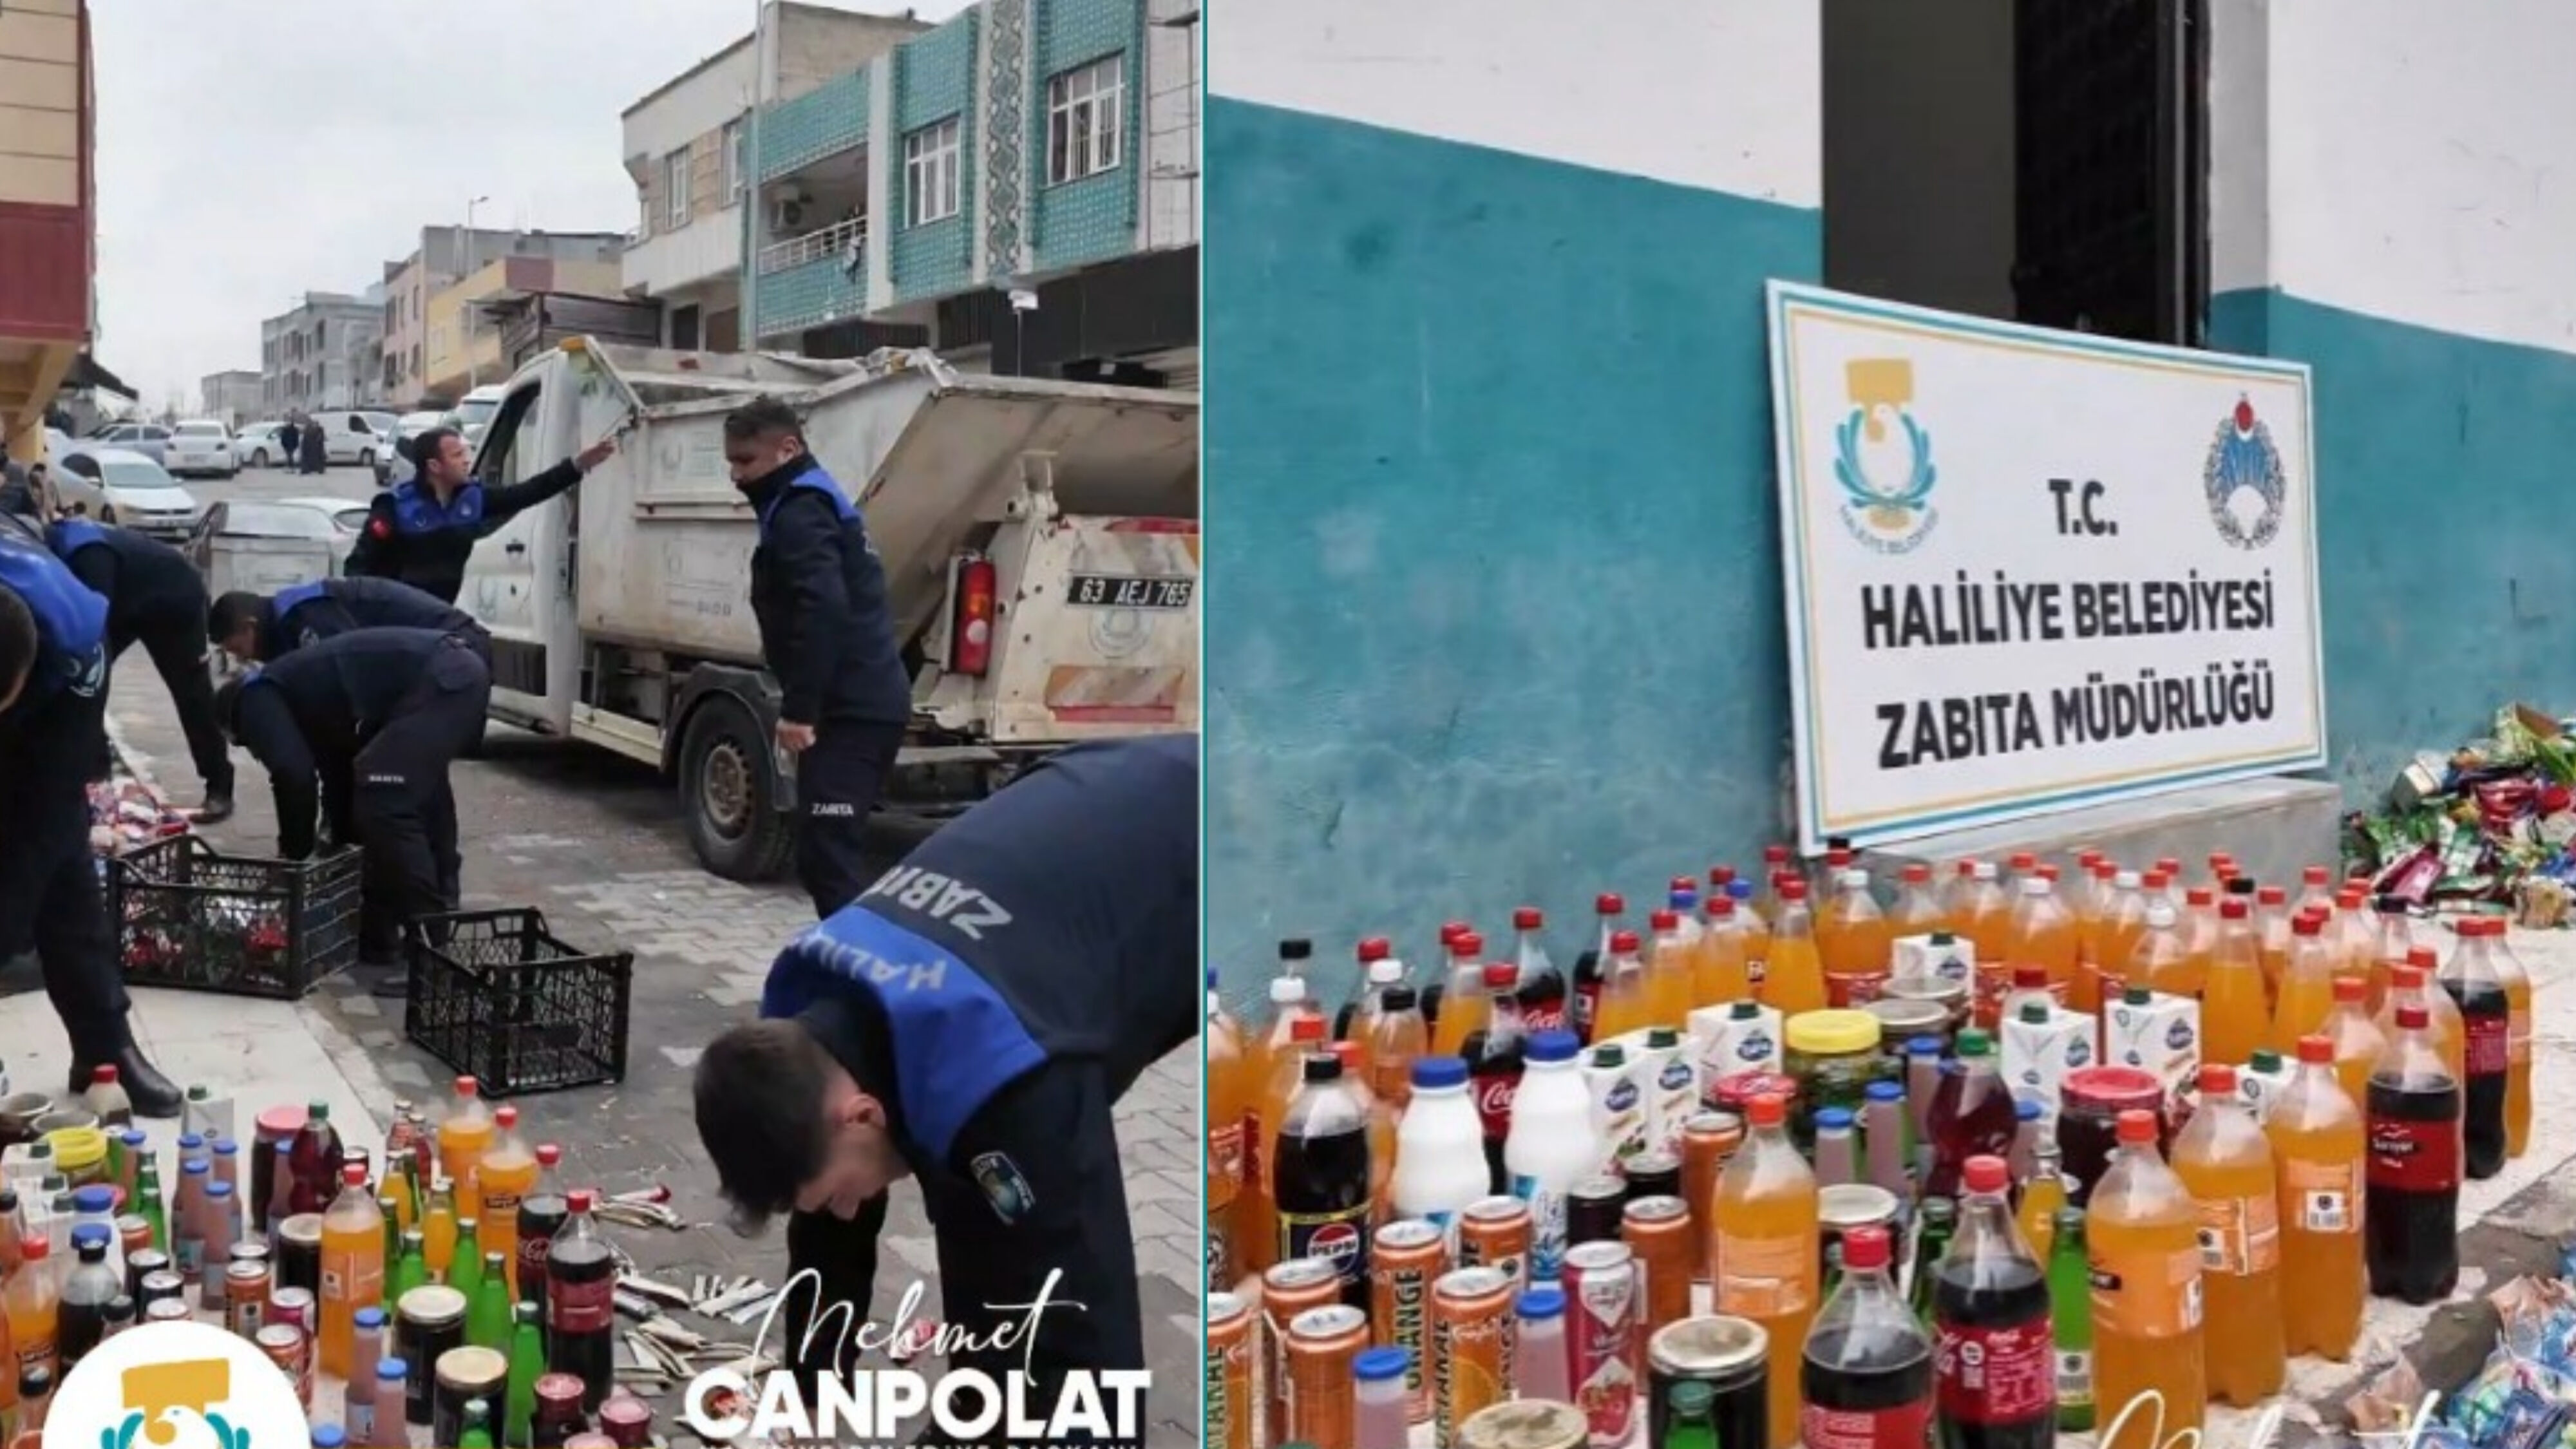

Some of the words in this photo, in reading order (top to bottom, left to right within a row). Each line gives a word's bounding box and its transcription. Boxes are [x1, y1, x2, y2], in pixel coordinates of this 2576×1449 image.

[2048, 479, 2118, 536] T.C.
[1079, 578, 1106, 603] 63
[1115, 580, 1152, 605] AEJ
[1157, 582, 1191, 605] 765
[1861, 570, 2063, 649] HALİLİYE
[2073, 569, 2274, 639] BELEDİYESİ
[1877, 690, 2044, 770] ZABITA
[2051, 659, 2275, 747] MÜDÜRLÜĞÜ
